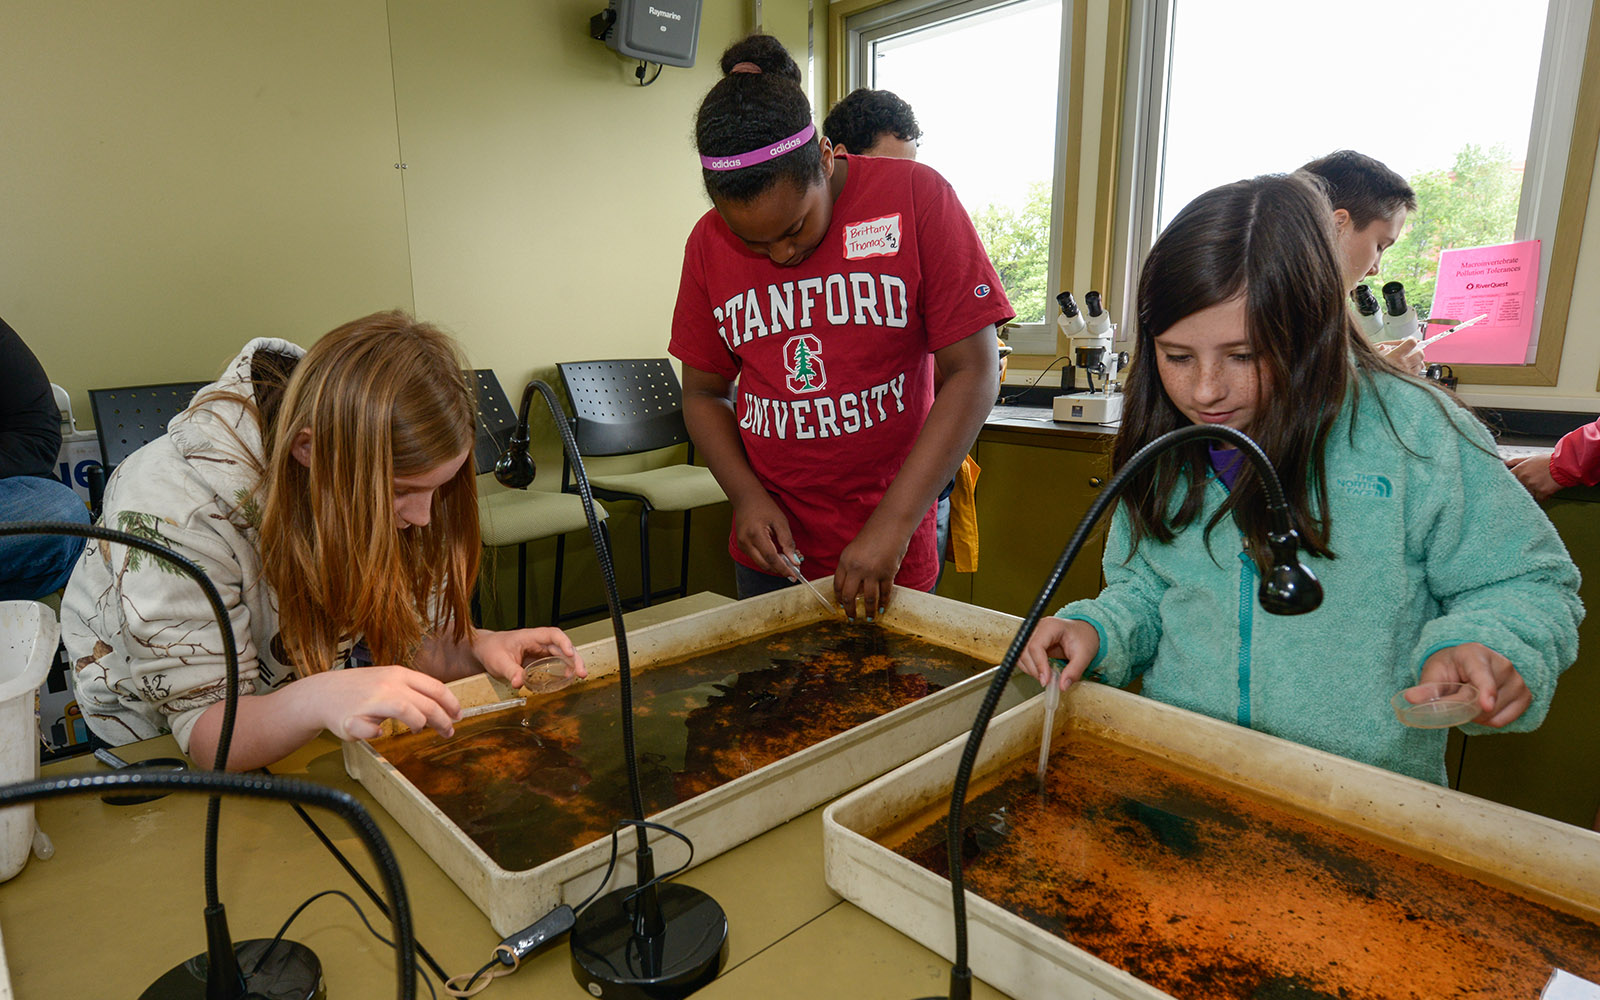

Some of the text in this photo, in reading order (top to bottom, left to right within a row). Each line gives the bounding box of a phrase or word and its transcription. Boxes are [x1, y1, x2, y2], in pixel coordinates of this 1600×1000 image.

[648, 6, 682, 21] Raymarine
[769, 137, 802, 156] adidas
[711, 158, 742, 169] adidas
[850, 223, 892, 239] Brittany
[849, 237, 886, 253] Thomas
[1455, 266, 1521, 277] Pollution Tolerances
[1475, 281, 1509, 289] RiverQuest
[712, 271, 908, 353] STANFORD
[739, 372, 906, 441] UNIVERSITY
[1337, 479, 1377, 489] NORTH
[1354, 473, 1377, 482] THE
[1346, 488, 1373, 496] FACE
